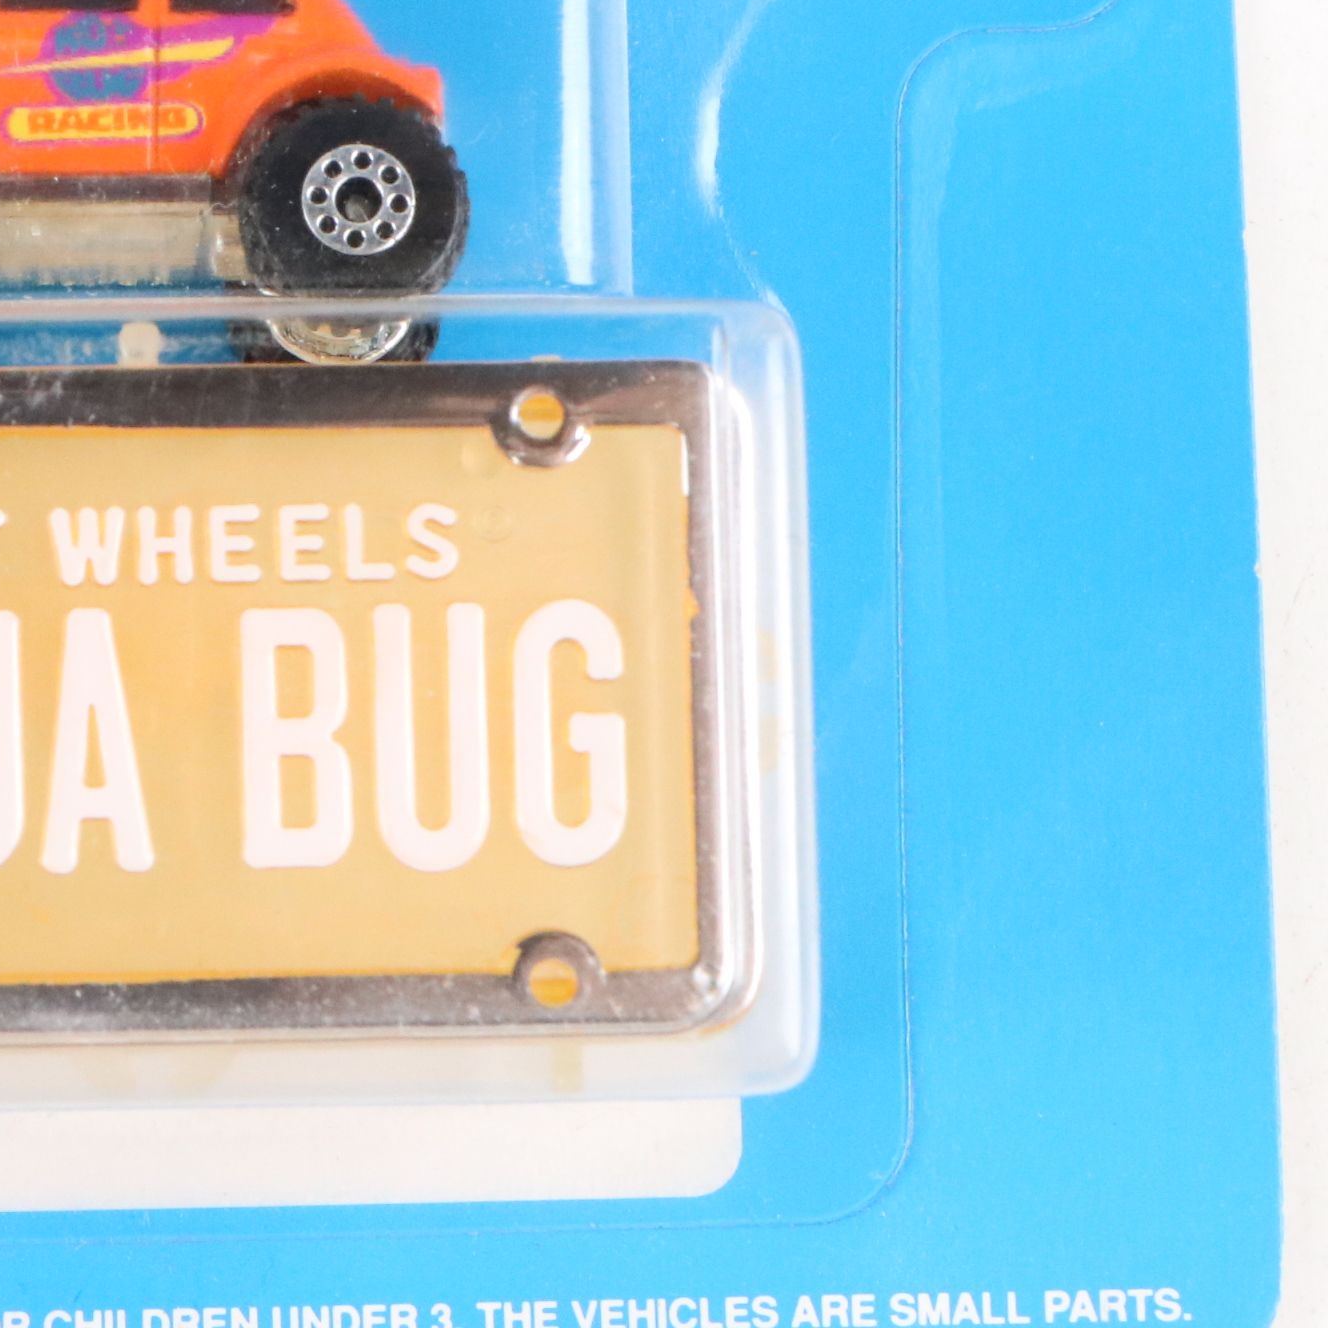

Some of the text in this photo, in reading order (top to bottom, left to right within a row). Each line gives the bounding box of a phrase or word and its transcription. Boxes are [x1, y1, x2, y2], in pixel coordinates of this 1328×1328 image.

[27, 105, 188, 135] RACING
[48, 503, 461, 587] WHEELS
[239, 598, 629, 873] BUG
[270, 1302, 419, 1328] UNDER
[430, 1302, 465, 1328] 3
[475, 1299, 560, 1328] THE
[570, 1294, 781, 1328] VEHICLES
[790, 1292, 880, 1328] ARE
[888, 1290, 1032, 1328] SMALL
[1043, 1286, 1193, 1324] PARTS.
